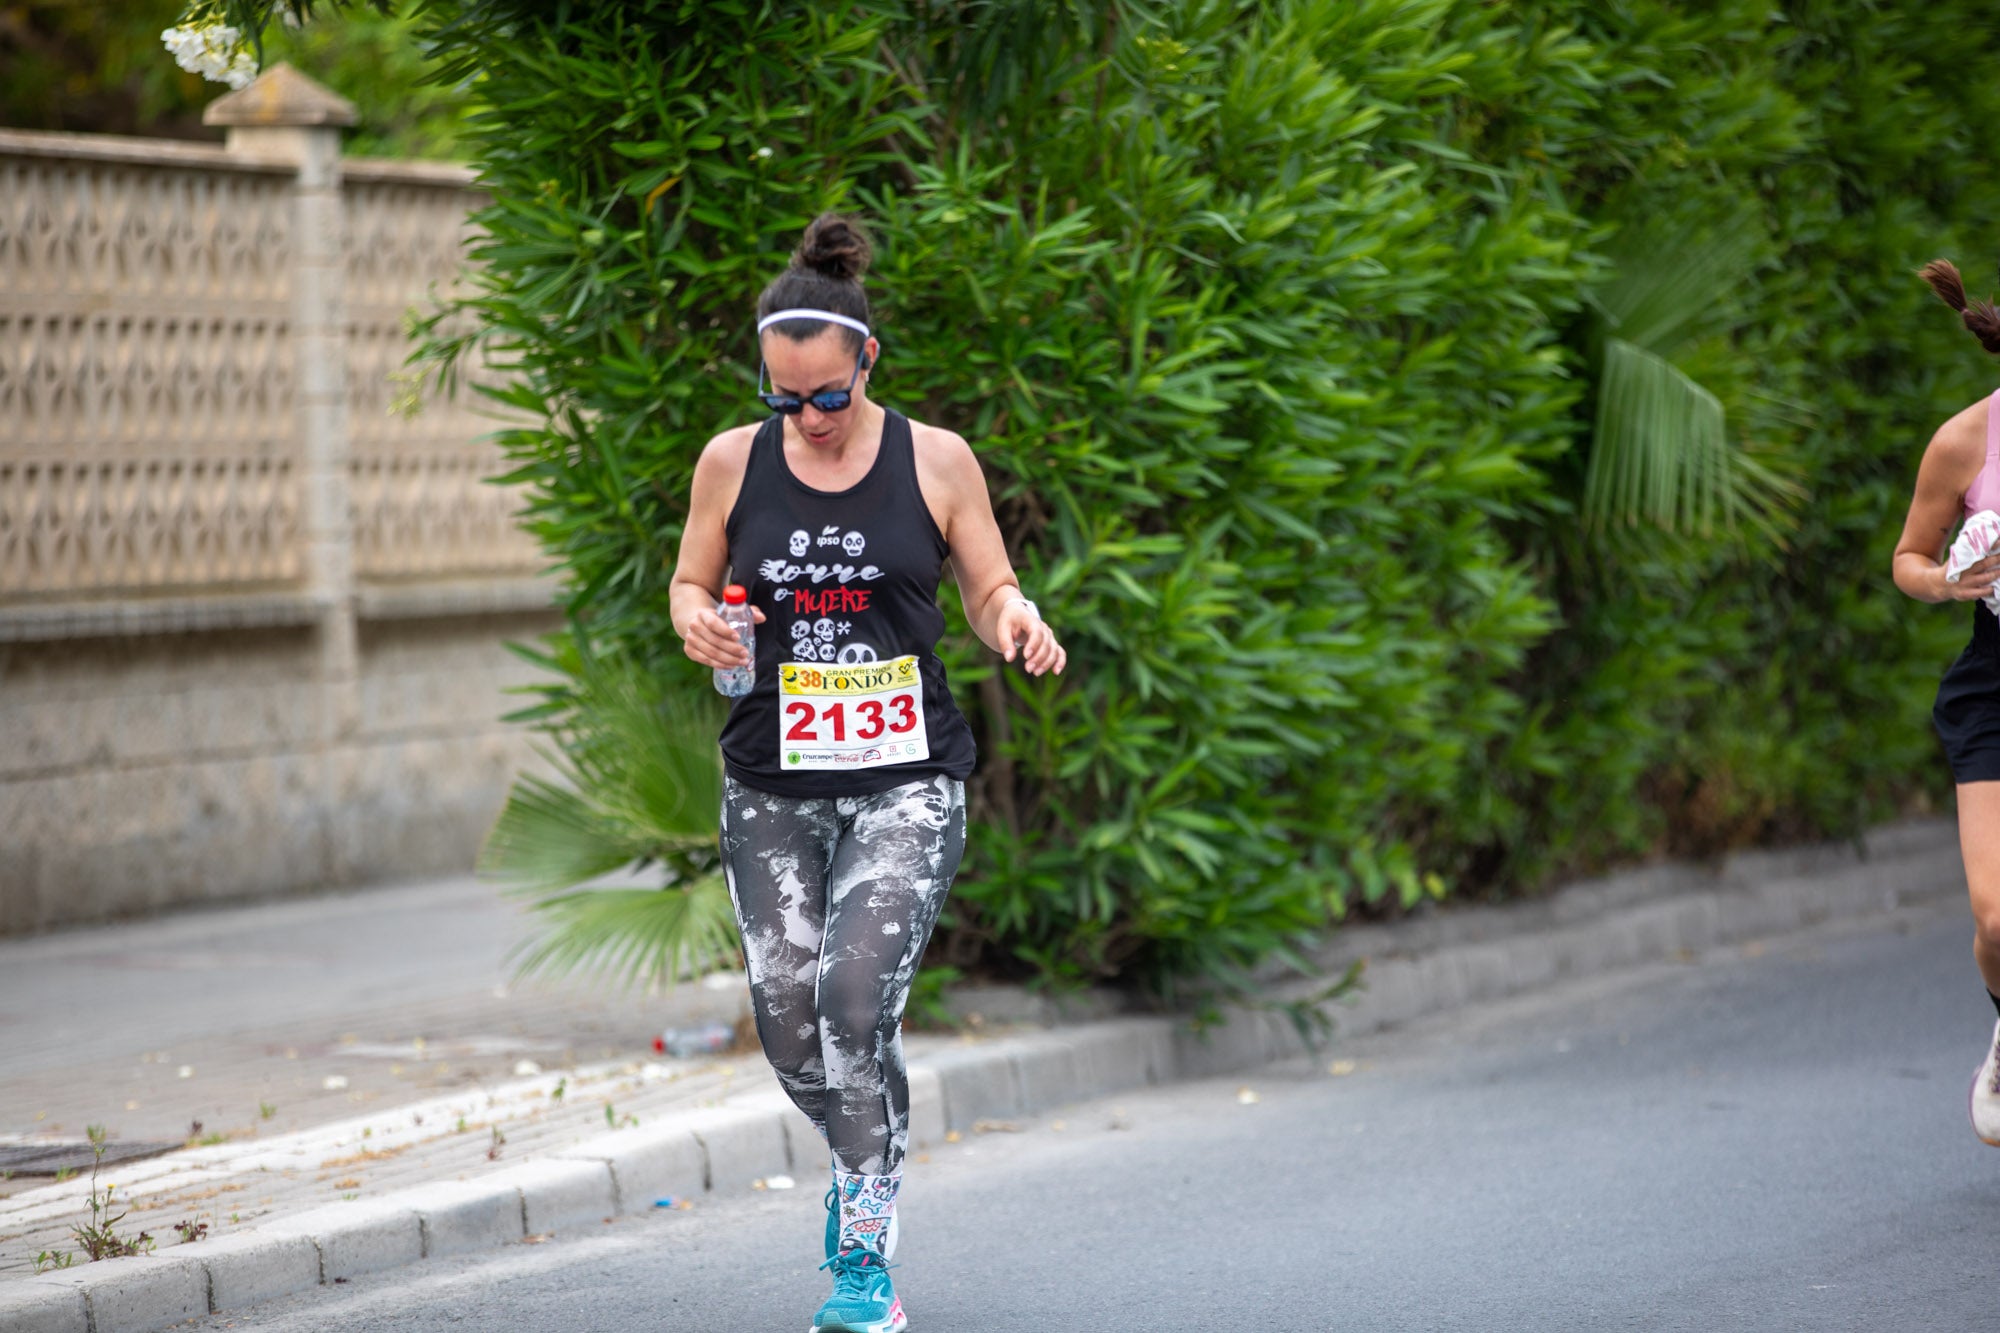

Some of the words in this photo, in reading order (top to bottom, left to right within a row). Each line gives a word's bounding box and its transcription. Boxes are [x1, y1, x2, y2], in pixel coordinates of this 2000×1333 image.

[816, 535, 840, 547] ipso
[794, 585, 872, 617] MUERE
[800, 669, 822, 687] 38
[822, 671, 893, 690] FONDO
[826, 669, 852, 677] GRAN
[785, 694, 917, 742] 2133
